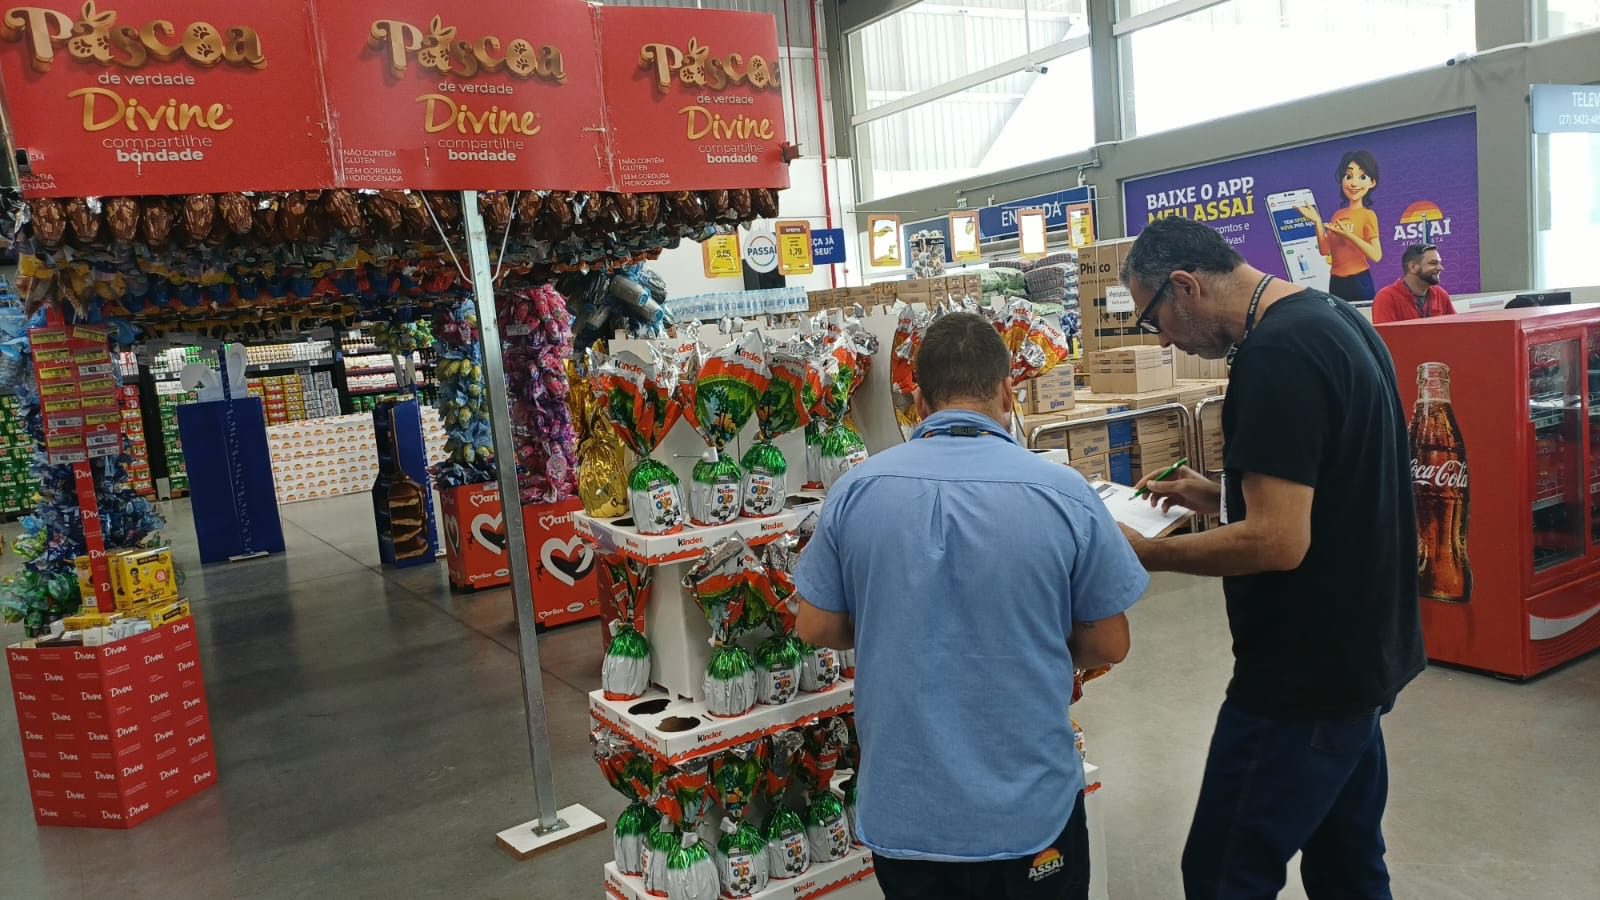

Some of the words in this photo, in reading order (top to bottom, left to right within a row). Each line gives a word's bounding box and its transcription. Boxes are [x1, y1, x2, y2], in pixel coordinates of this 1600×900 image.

[98, 72, 121, 85] de
[126, 72, 195, 86] verdade
[438, 82, 456, 92] de
[458, 82, 514, 95] verdade
[697, 94, 713, 104] de
[716, 94, 754, 105] verdade
[68, 88, 234, 132] Divine
[416, 94, 541, 135] Divine
[677, 106, 775, 141] Divine
[102, 135, 213, 150] compartilhe
[438, 138, 524, 151] compartilhe
[698, 143, 764, 155] compartilhe
[117, 148, 204, 162] bondade
[448, 149, 517, 162] bondade
[707, 152, 758, 164] bondade
[1146, 187, 1196, 210] BAIXE
[1201, 184, 1212, 200] O
[1218, 176, 1254, 198] APP
[1148, 205, 1188, 224] MEU
[1194, 191, 1254, 222] ASSAÍ
[1002, 202, 1062, 227] ENDA
[1080, 262, 1110, 275] Phico
[734, 344, 762, 364] Kinder
[615, 360, 644, 375] Kinde
[760, 522, 784, 532] Kinder
[678, 536, 702, 546] Kinder
[172, 623, 190, 634] Divine
[12, 652, 28, 662] Divine
[74, 652, 96, 660] Divine
[103, 645, 127, 657] Divine
[144, 652, 164, 665] Divine
[177, 660, 195, 672] Divine
[44, 672, 64, 682] Divine
[18, 692, 36, 702] Divine
[80, 692, 103, 701] Divine
[110, 684, 133, 698] Divine
[149, 691, 169, 704] Divine
[182, 698, 200, 710] Divine
[51, 712, 72, 721] Divine
[25, 730, 44, 740] Divine
[88, 732, 109, 741] Divine
[116, 724, 139, 738] Divine
[154, 729, 174, 742] Divine
[697, 730, 722, 743] Kinder
[188, 734, 206, 747] Divine
[58, 752, 79, 760] Divine
[32, 769, 50, 779] Divine
[94, 770, 115, 780] Divine
[122, 763, 144, 776] Divine
[160, 767, 180, 781] Divine
[192, 770, 212, 784] Divine
[66, 790, 86, 800] Divine
[40, 808, 58, 818] Divine
[102, 810, 122, 820] Divine
[128, 802, 150, 817] Divine
[793, 880, 816, 894] Kinder
